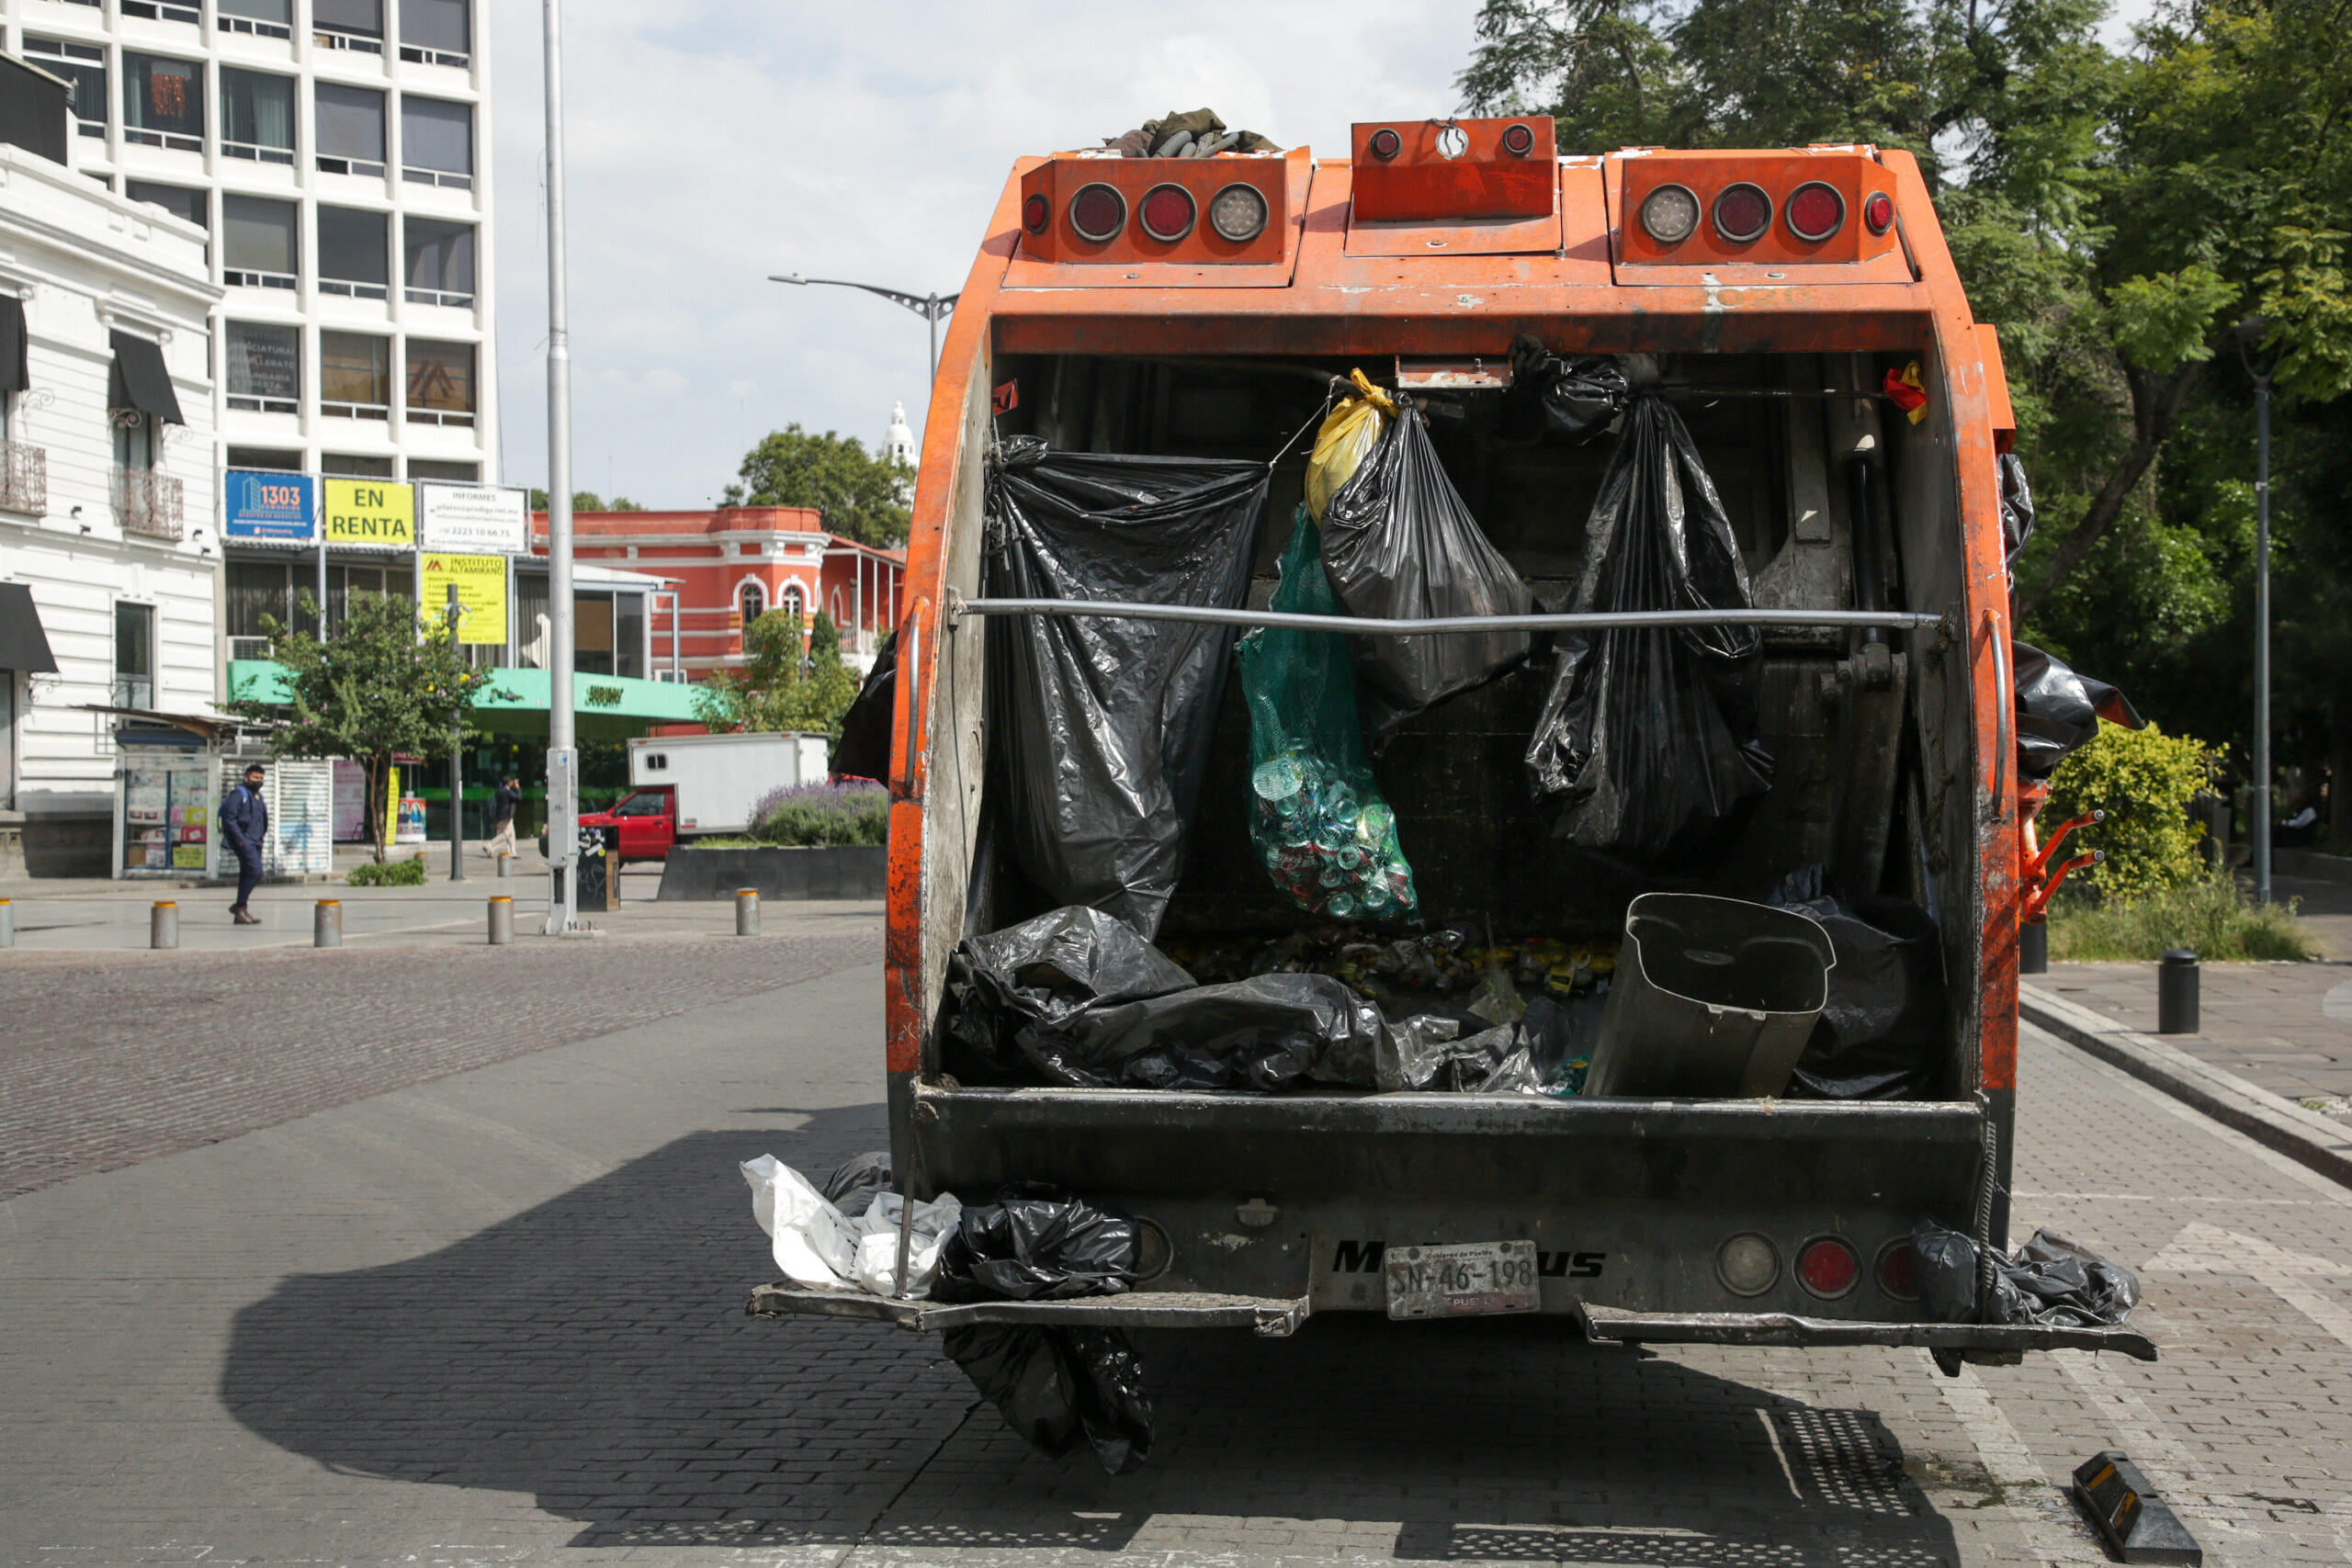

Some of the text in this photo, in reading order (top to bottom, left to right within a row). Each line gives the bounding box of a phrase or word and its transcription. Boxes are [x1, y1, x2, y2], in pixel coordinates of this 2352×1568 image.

[261, 485, 300, 505] 1303
[355, 489, 384, 508] EN
[452, 491, 497, 502] INFORMES
[333, 516, 407, 536] RENTA
[452, 527, 511, 538] 2223 10 66 75
[450, 558, 503, 568] INSTITUTO
[449, 566, 503, 576] ALTAMIRANO
[1469, 1249, 1493, 1258] Puebla
[1392, 1259, 1532, 1294] SN-46-198
